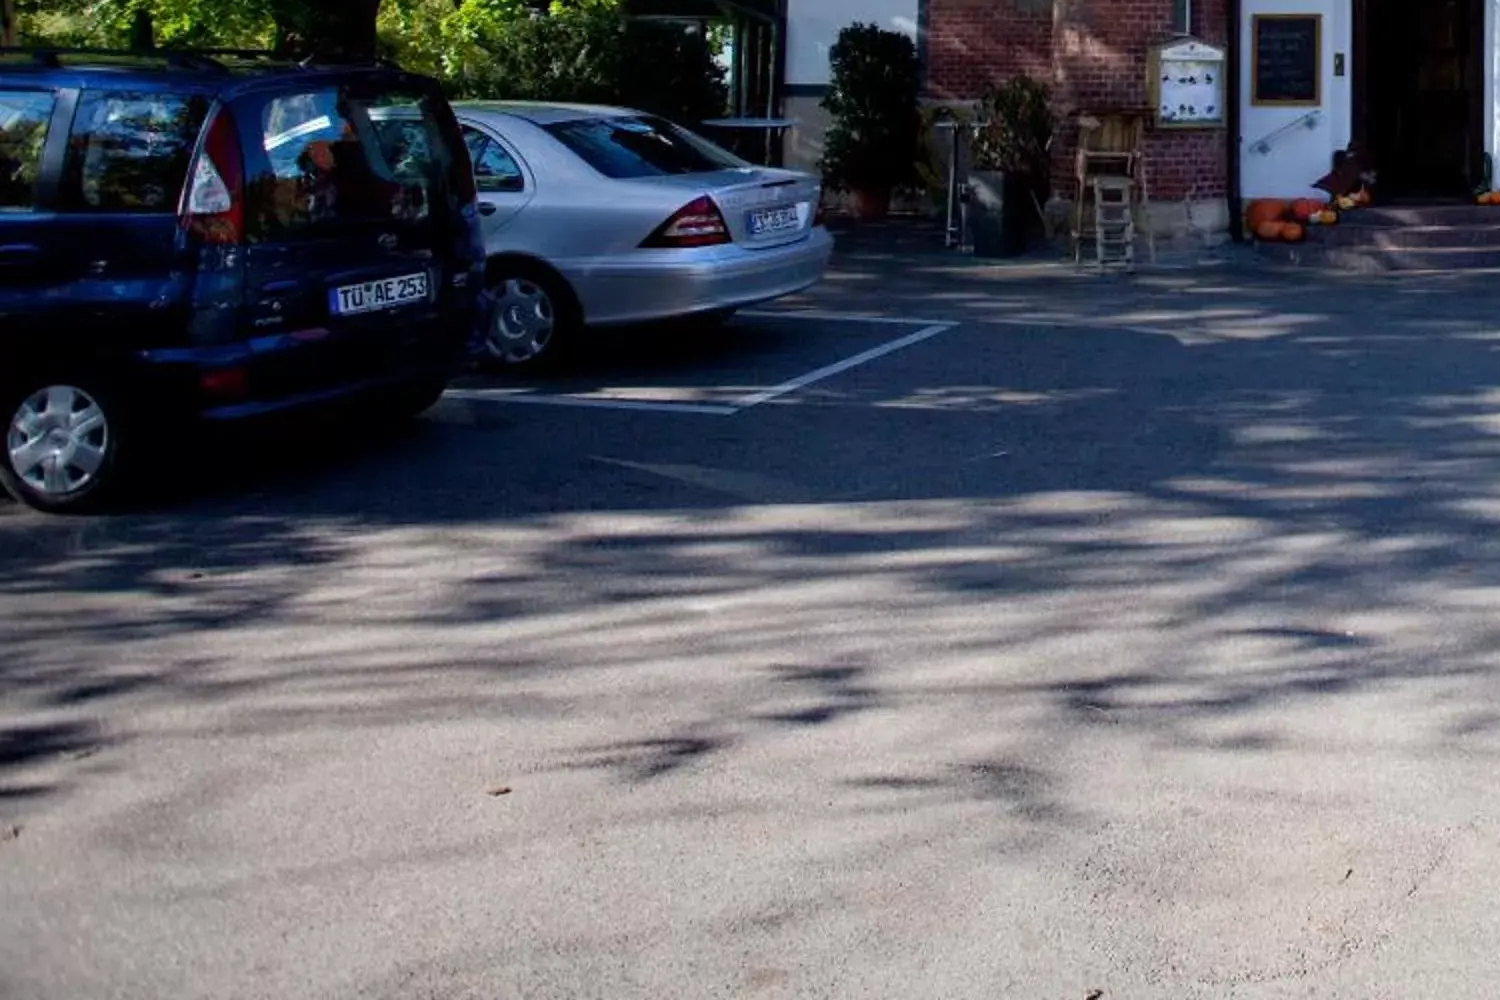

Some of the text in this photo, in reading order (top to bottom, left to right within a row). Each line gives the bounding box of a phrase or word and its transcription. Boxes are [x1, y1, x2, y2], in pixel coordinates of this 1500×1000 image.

[340, 276, 425, 309] TÜ AE 253
